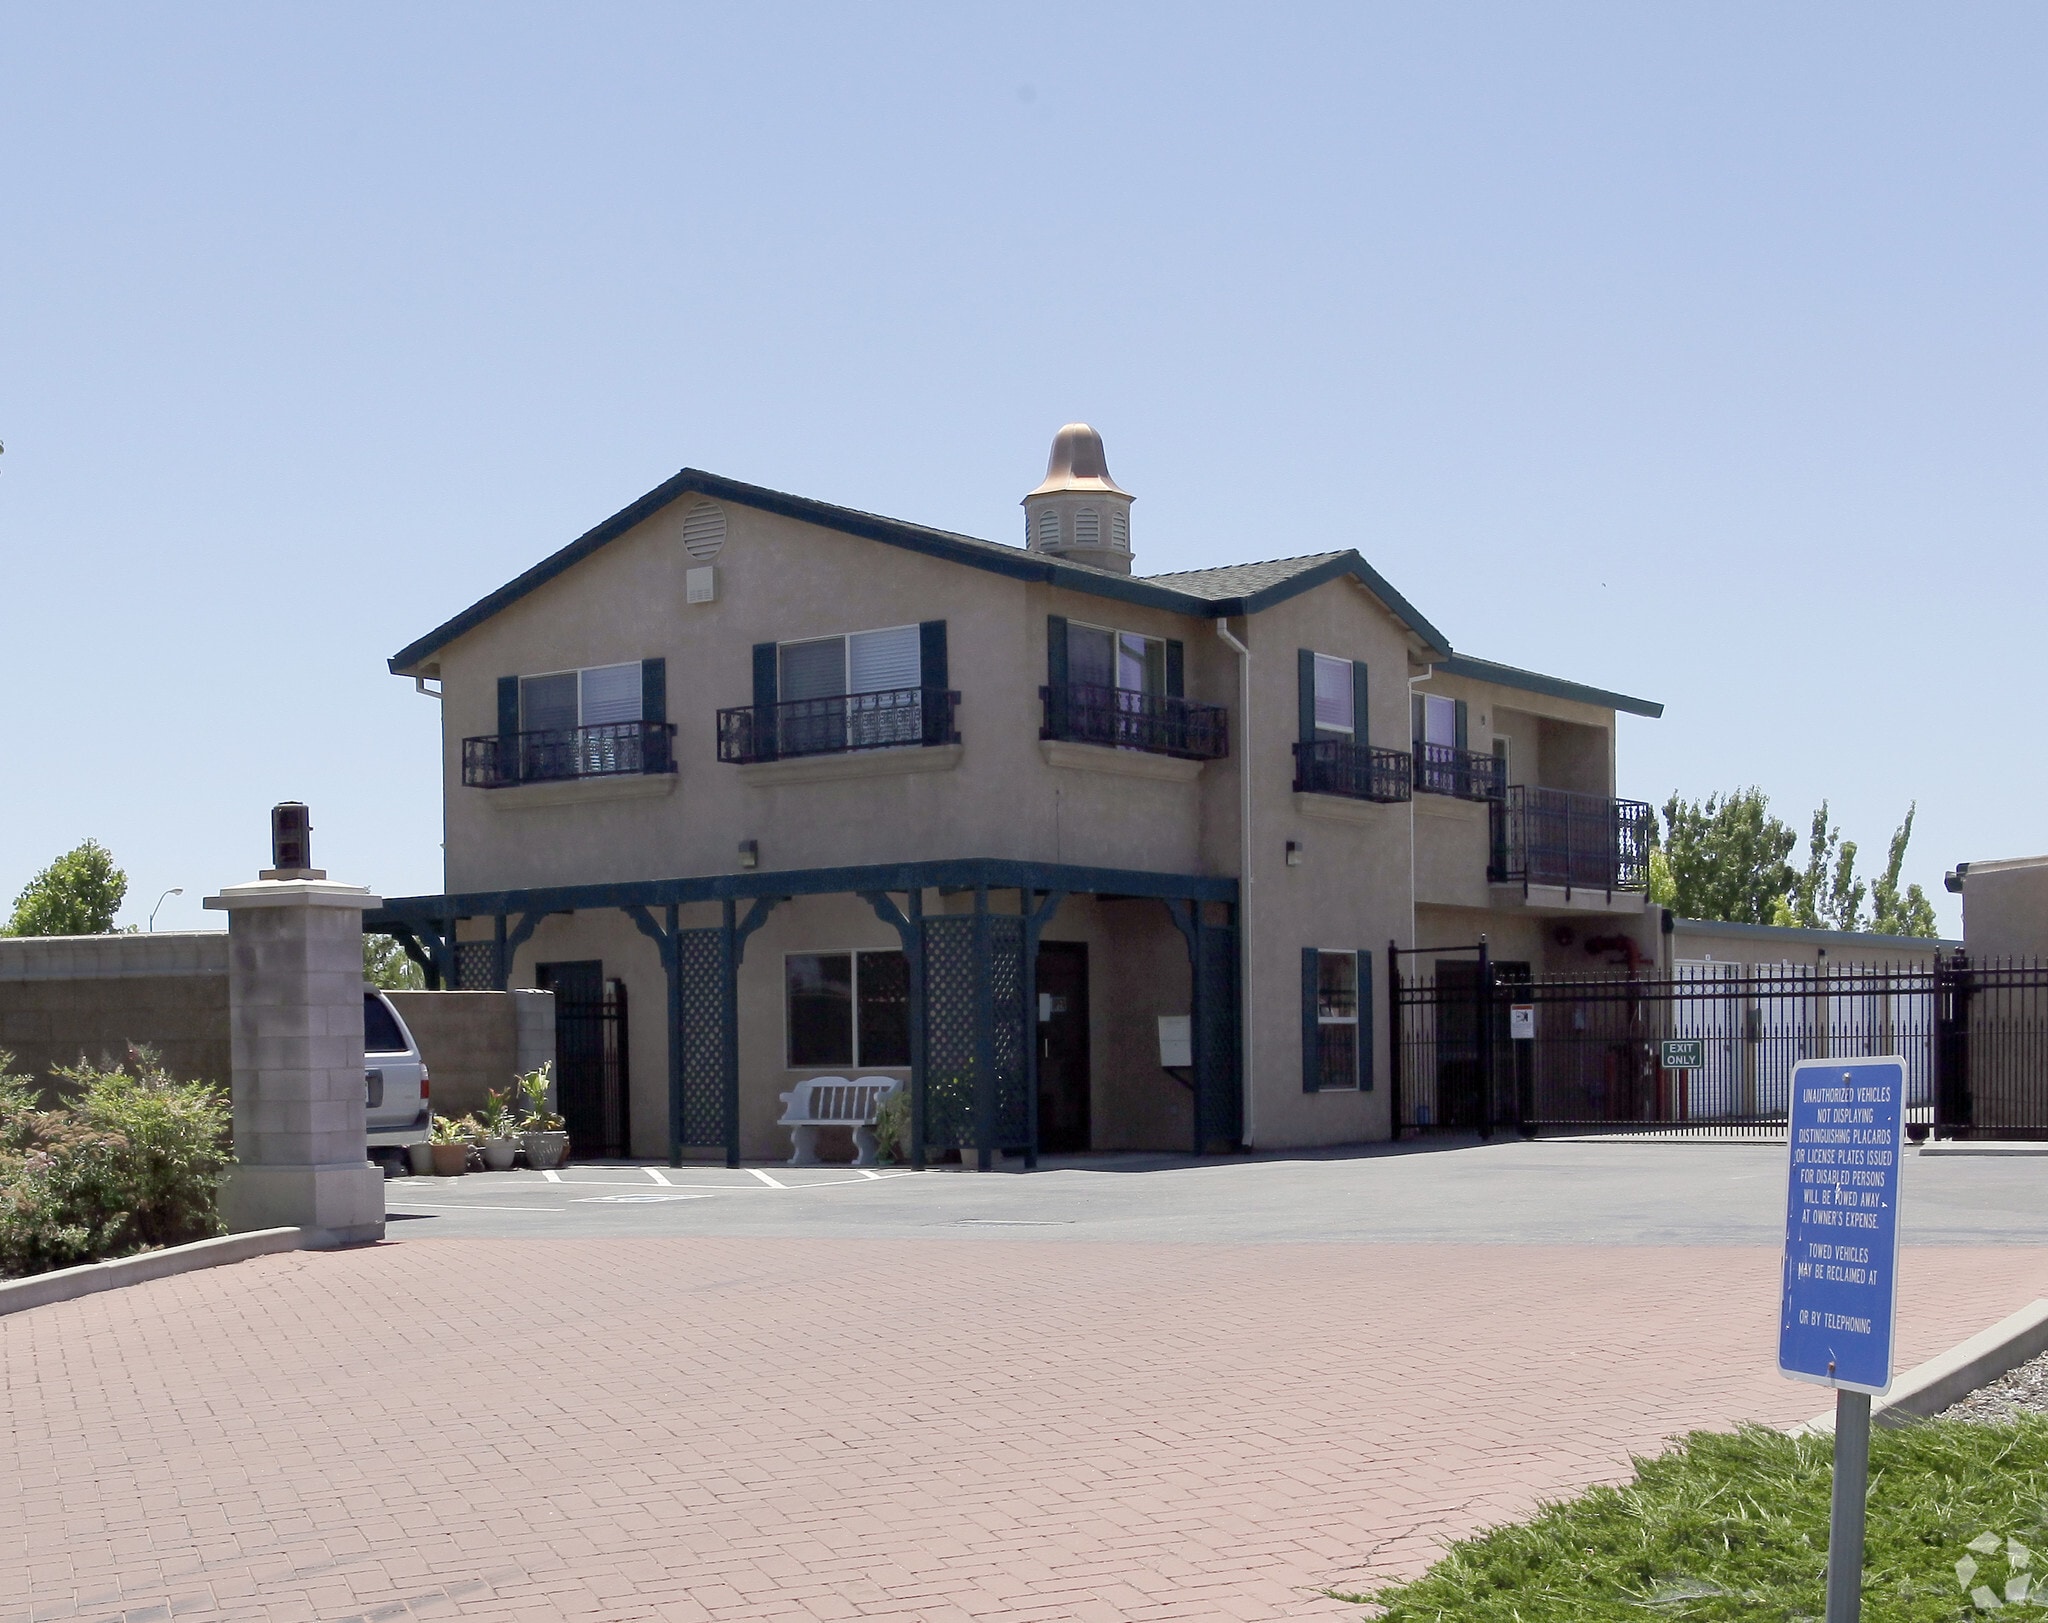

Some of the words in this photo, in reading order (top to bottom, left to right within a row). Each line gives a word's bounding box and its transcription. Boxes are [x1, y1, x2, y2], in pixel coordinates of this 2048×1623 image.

[1670, 1044, 1693, 1053] EXIT
[1667, 1055, 1696, 1064] ONLY
[1803, 1088, 1854, 1103] UNAUTHORIZED
[1857, 1087, 1891, 1102] VEHICLES
[1817, 1109, 1830, 1123] NOT
[1834, 1109, 1873, 1123] DISPLAYING
[1799, 1129, 1850, 1144] DISTINGUISHING
[1853, 1130, 1891, 1144] PLACARDS
[1796, 1149, 1804, 1163] OR
[1808, 1150, 1835, 1164] LICENSE
[1838, 1150, 1864, 1165] PLATES
[1867, 1151, 1892, 1166] ISSUED
[1801, 1169, 1813, 1183] FOR
[1816, 1170, 1850, 1185] DISABLED
[1852, 1171, 1885, 1186] PERSONS
[1803, 1189, 1819, 1204] WILL
[1822, 1189, 1831, 1205] BE
[1860, 1192, 1880, 1207] AWAY
[1802, 1209, 1810, 1224] AT
[1812, 1209, 1843, 1227] OWNER'S
[1845, 1212, 1880, 1229] EXPENSE.
[1809, 1244, 1831, 1259] TOWED
[1836, 1246, 1868, 1264] VEHICLES
[1798, 1262, 1813, 1277] MAY
[1815, 1264, 1824, 1279] BE
[1826, 1265, 1866, 1284] RECLAIMED
[1868, 1270, 1878, 1285] AT
[1799, 1310, 1809, 1324] OR
[1812, 1311, 1821, 1326] BY
[1824, 1313, 1871, 1334] TELEPHONING
